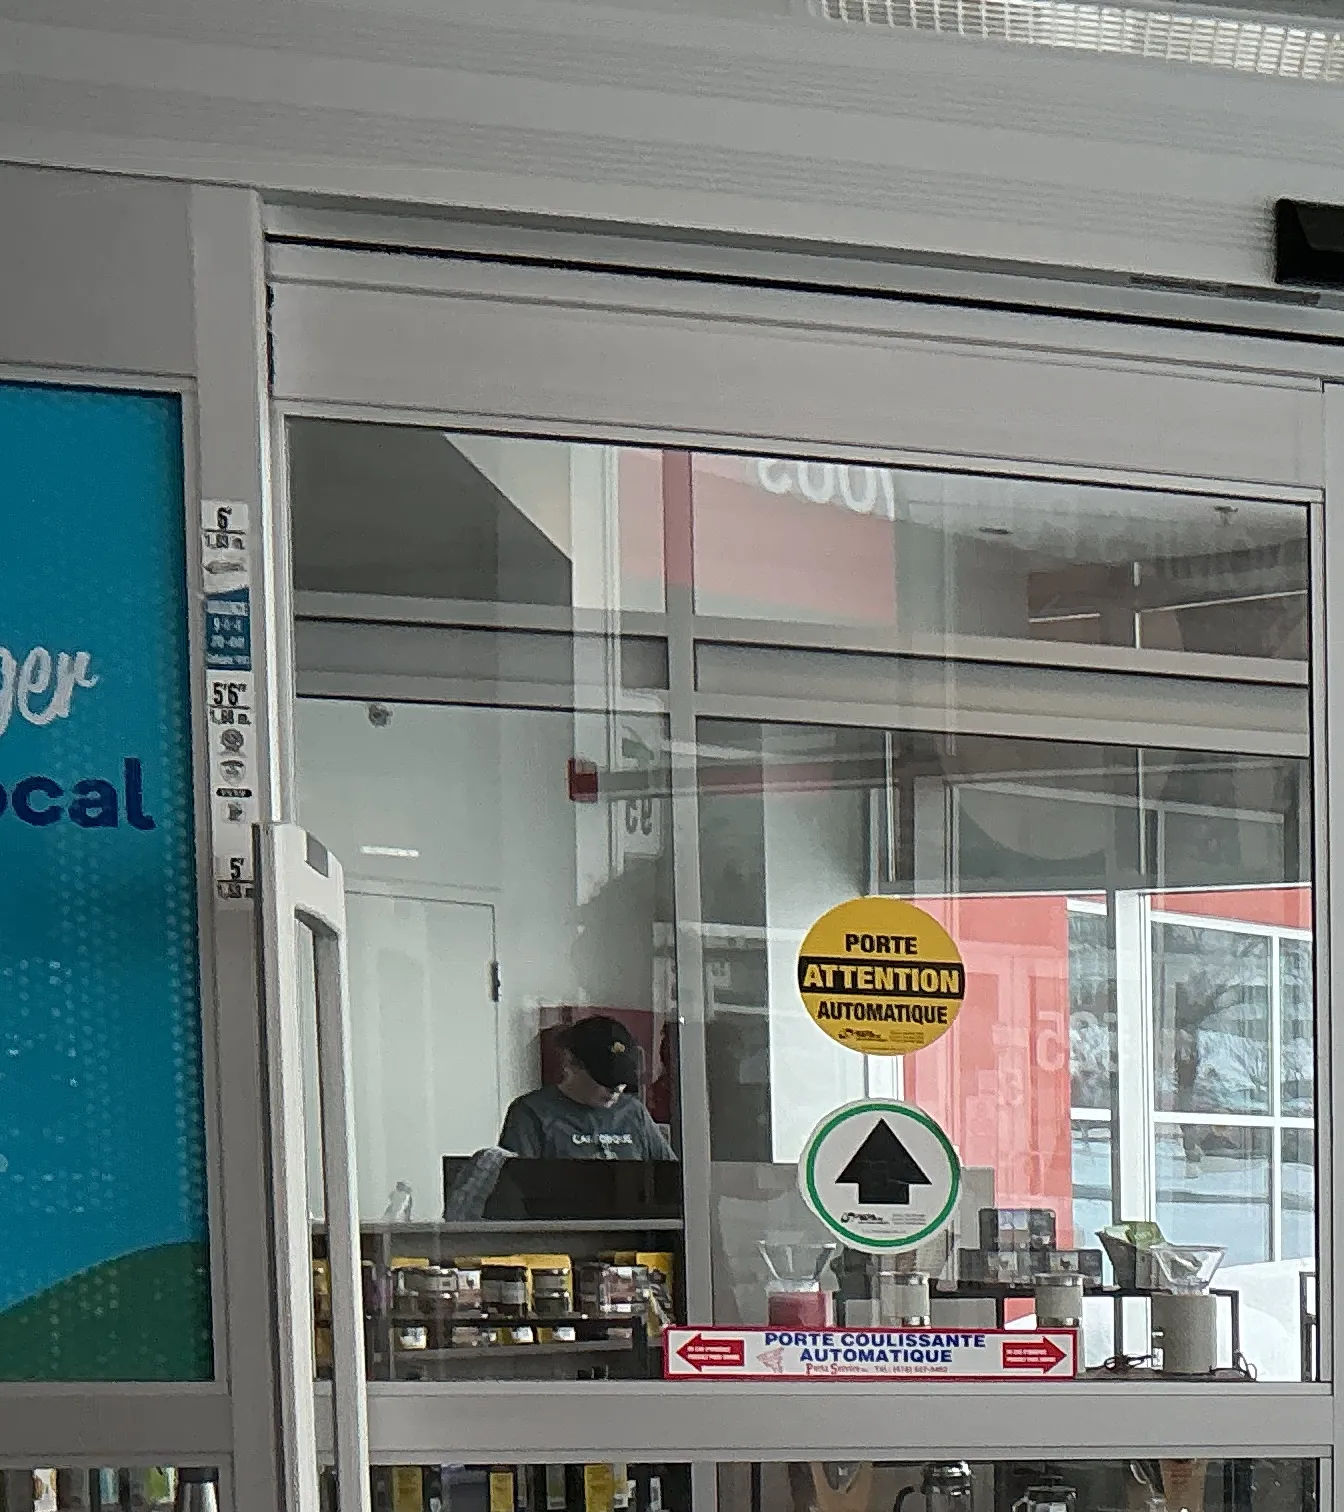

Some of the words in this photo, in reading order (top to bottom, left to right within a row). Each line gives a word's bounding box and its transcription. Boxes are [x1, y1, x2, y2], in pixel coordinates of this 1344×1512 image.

[0, 756, 157, 831] cal
[845, 933, 918, 955] PORTE
[803, 963, 960, 994] ATTENTION
[818, 1001, 948, 1025] AUTOMATIQUE
[764, 1332, 834, 1348] PORTE
[840, 1333, 987, 1348] COULISSANTE
[800, 1348, 952, 1363] AUTOMATIQUE
